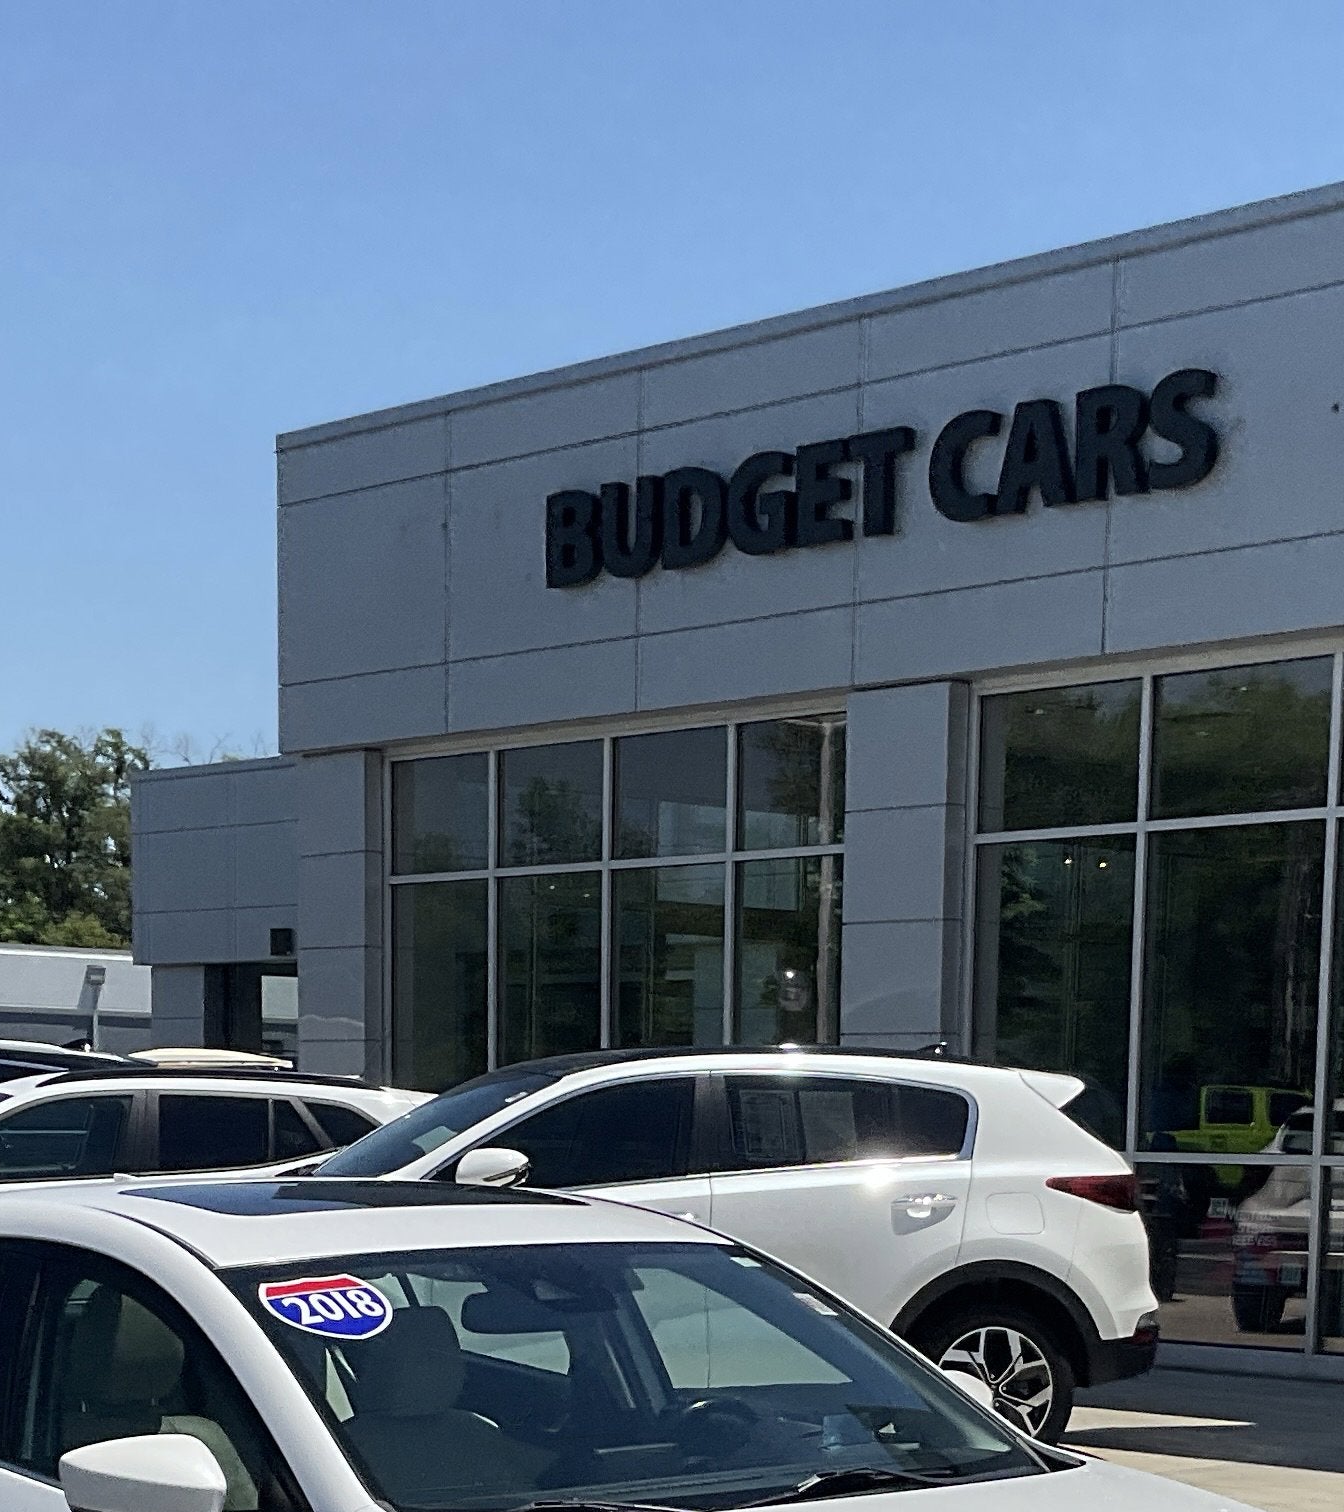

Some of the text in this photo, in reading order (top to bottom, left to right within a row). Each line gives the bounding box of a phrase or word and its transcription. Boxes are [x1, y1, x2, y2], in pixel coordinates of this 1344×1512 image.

[545, 368, 1222, 589] BUDGET CARS
[281, 1289, 385, 1325] 2018
